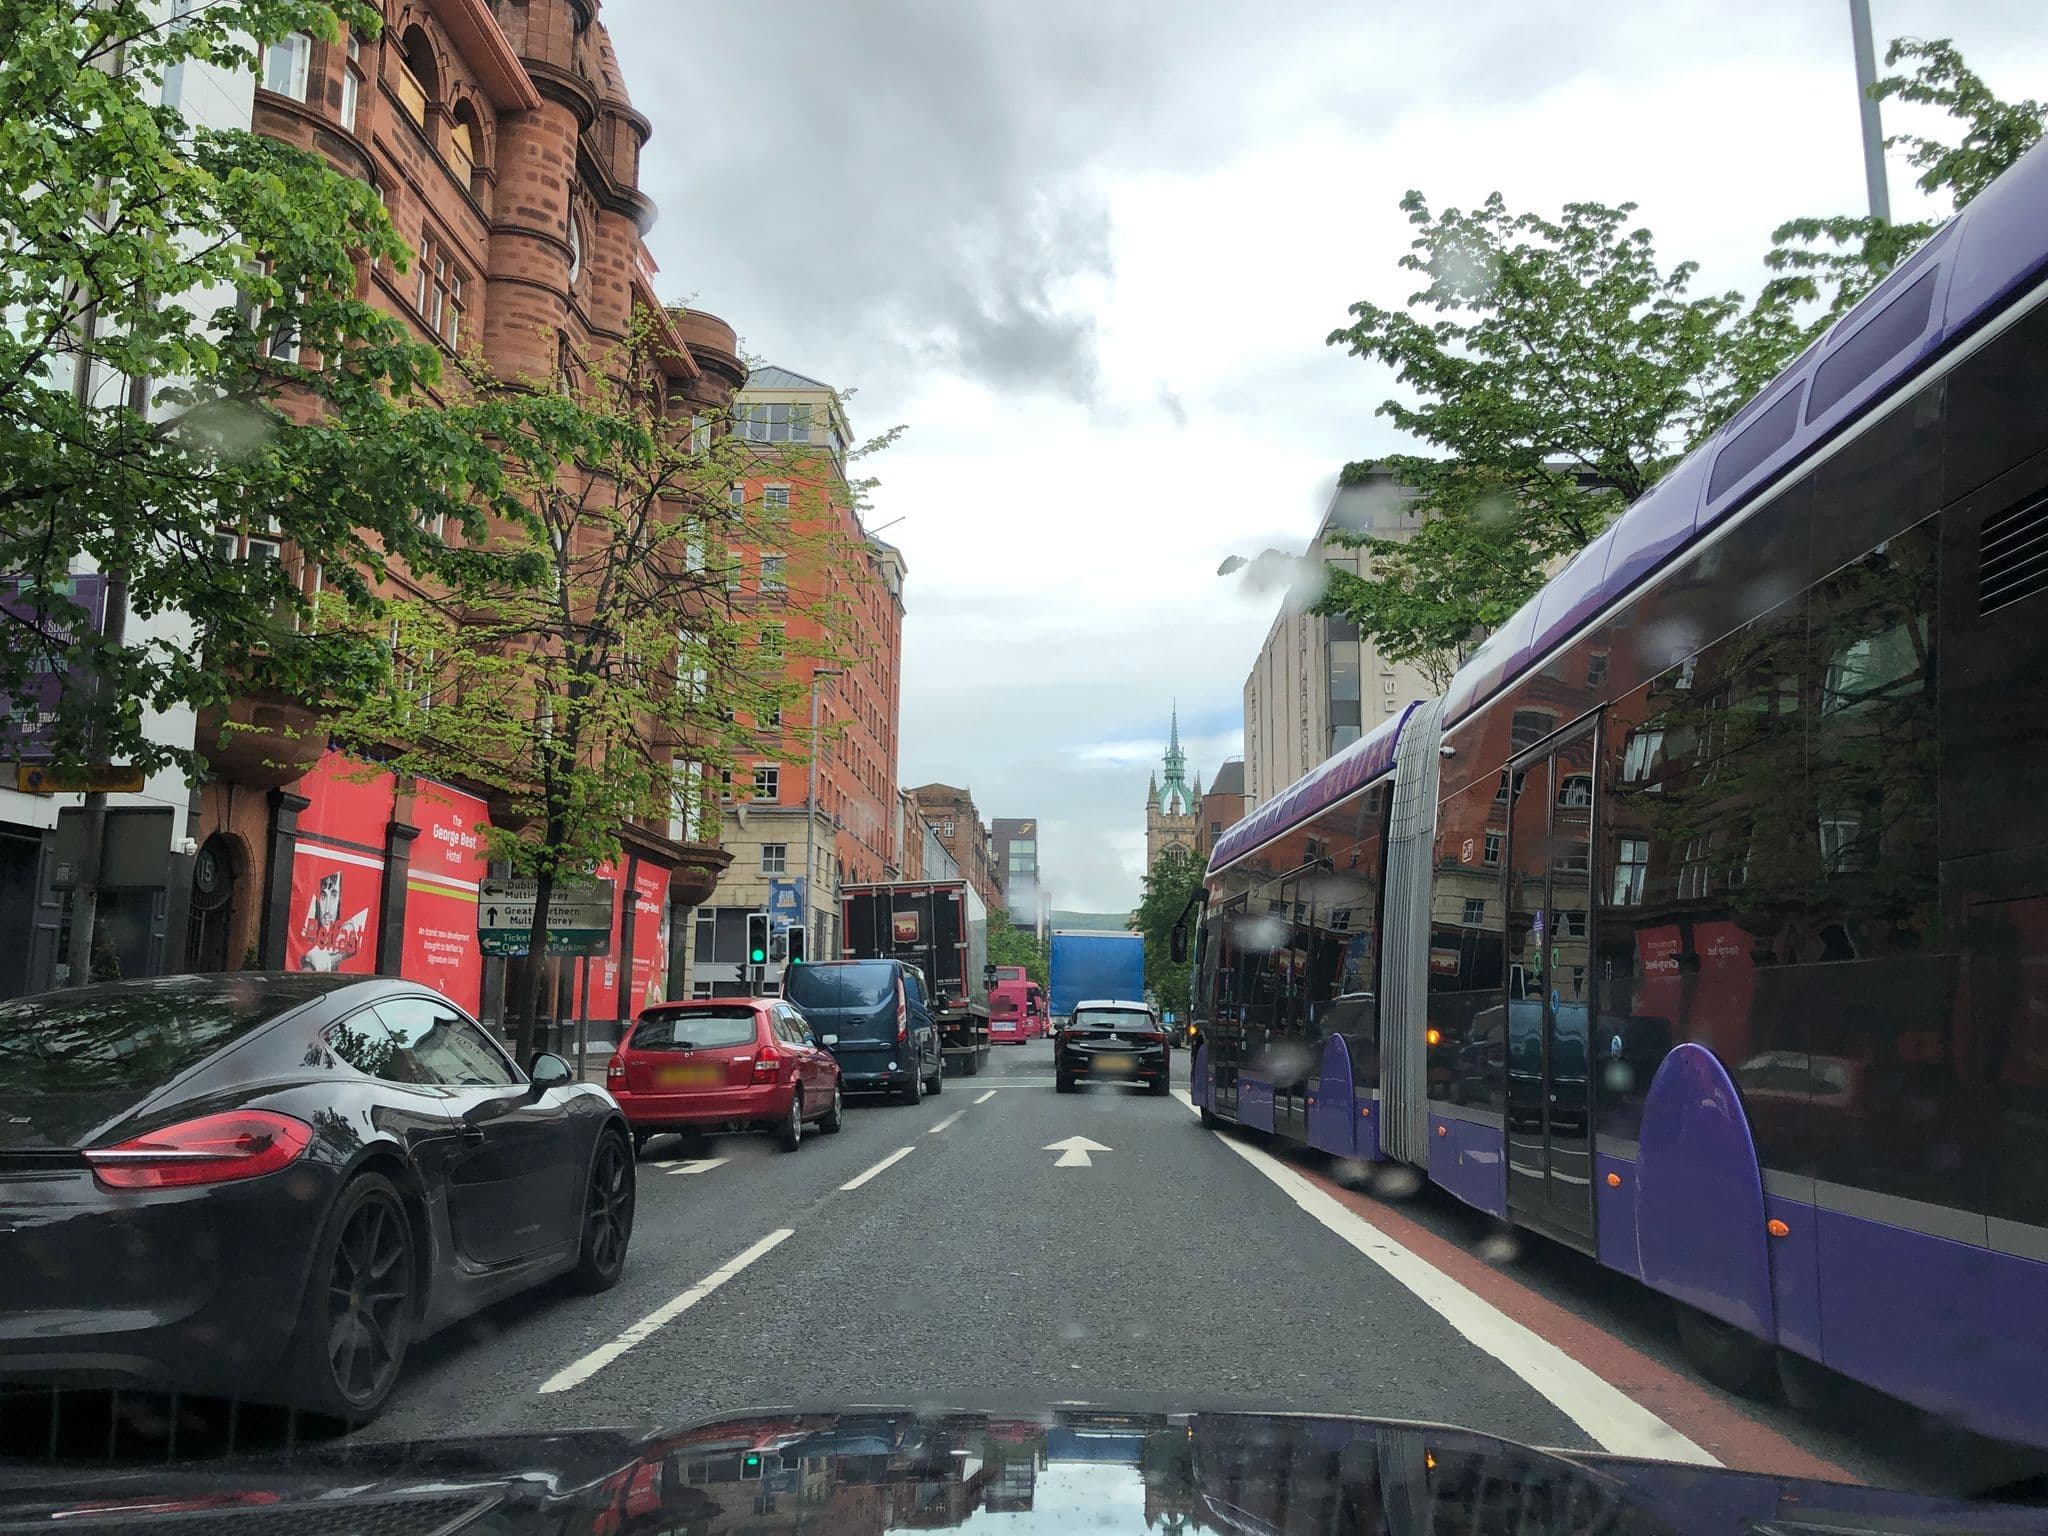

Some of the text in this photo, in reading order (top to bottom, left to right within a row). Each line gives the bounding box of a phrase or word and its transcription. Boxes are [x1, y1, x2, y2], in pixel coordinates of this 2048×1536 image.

[452, 814, 462, 828] The
[433, 824, 477, 850] George Best
[446, 849, 462, 864] Hotel
[504, 906, 580, 916] Great rthern
